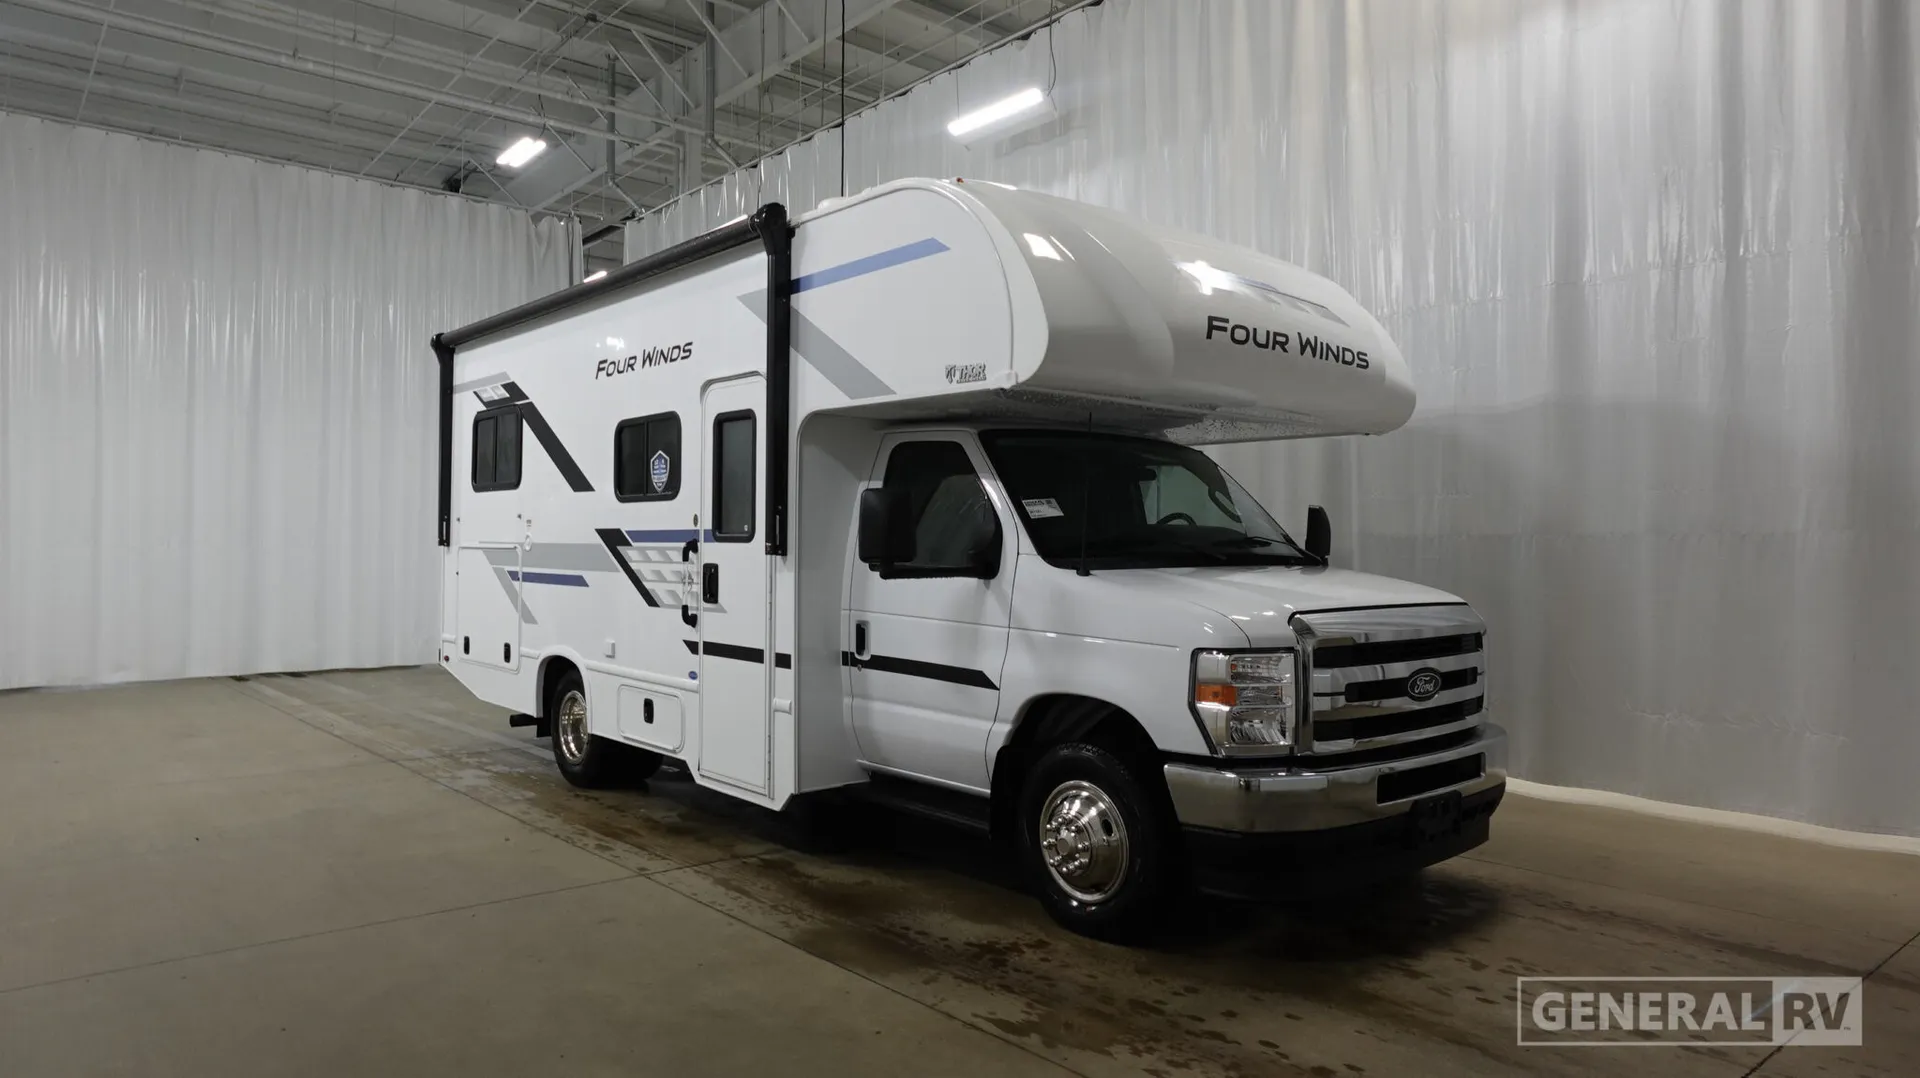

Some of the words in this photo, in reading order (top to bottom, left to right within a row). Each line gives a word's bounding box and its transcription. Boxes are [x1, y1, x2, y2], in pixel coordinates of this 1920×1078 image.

[595, 355, 638, 380] FOUR
[641, 341, 694, 369] WINDS
[1205, 315, 1290, 353] FOUR
[1297, 331, 1370, 370] WINDS
[1414, 676, 1436, 693] Ford
